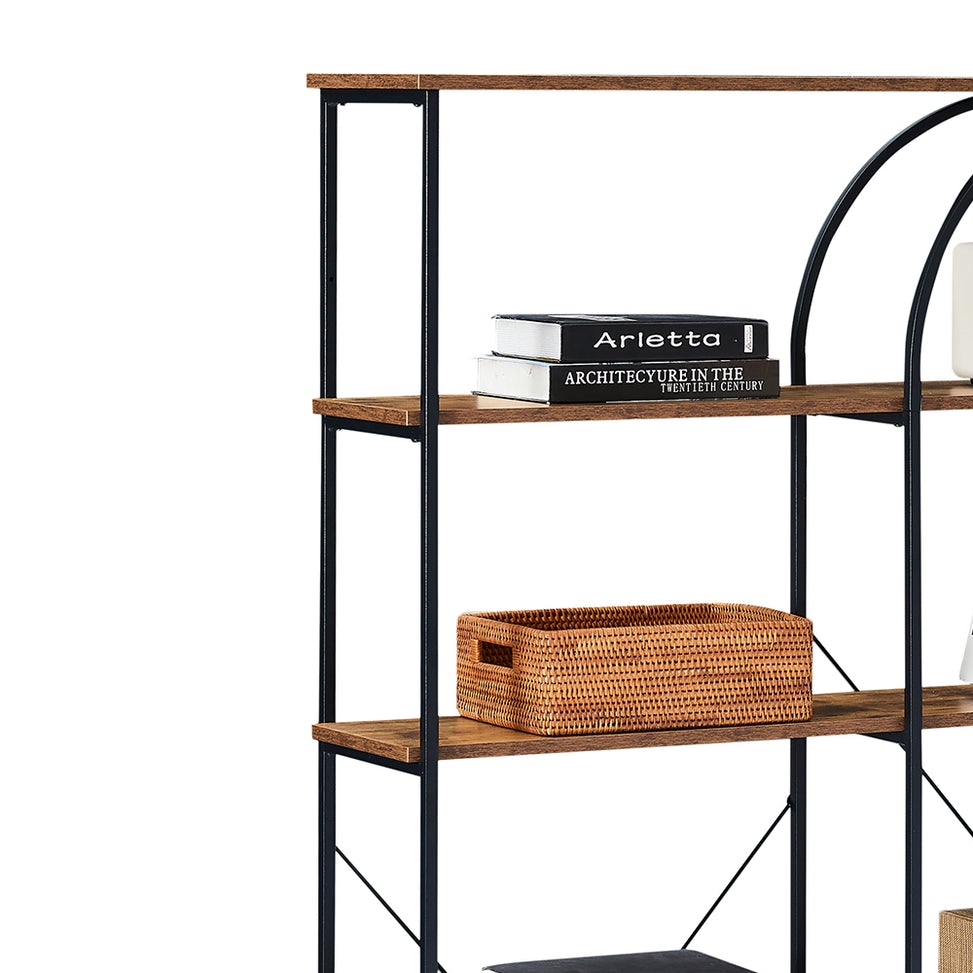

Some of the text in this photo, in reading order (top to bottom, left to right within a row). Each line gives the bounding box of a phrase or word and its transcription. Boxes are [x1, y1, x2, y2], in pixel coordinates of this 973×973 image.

[593, 331, 721, 349] Arletta
[565, 367, 744, 386] ARCHITECYURE IN THE
[660, 380, 764, 394] TWENTIETH CENTURY
